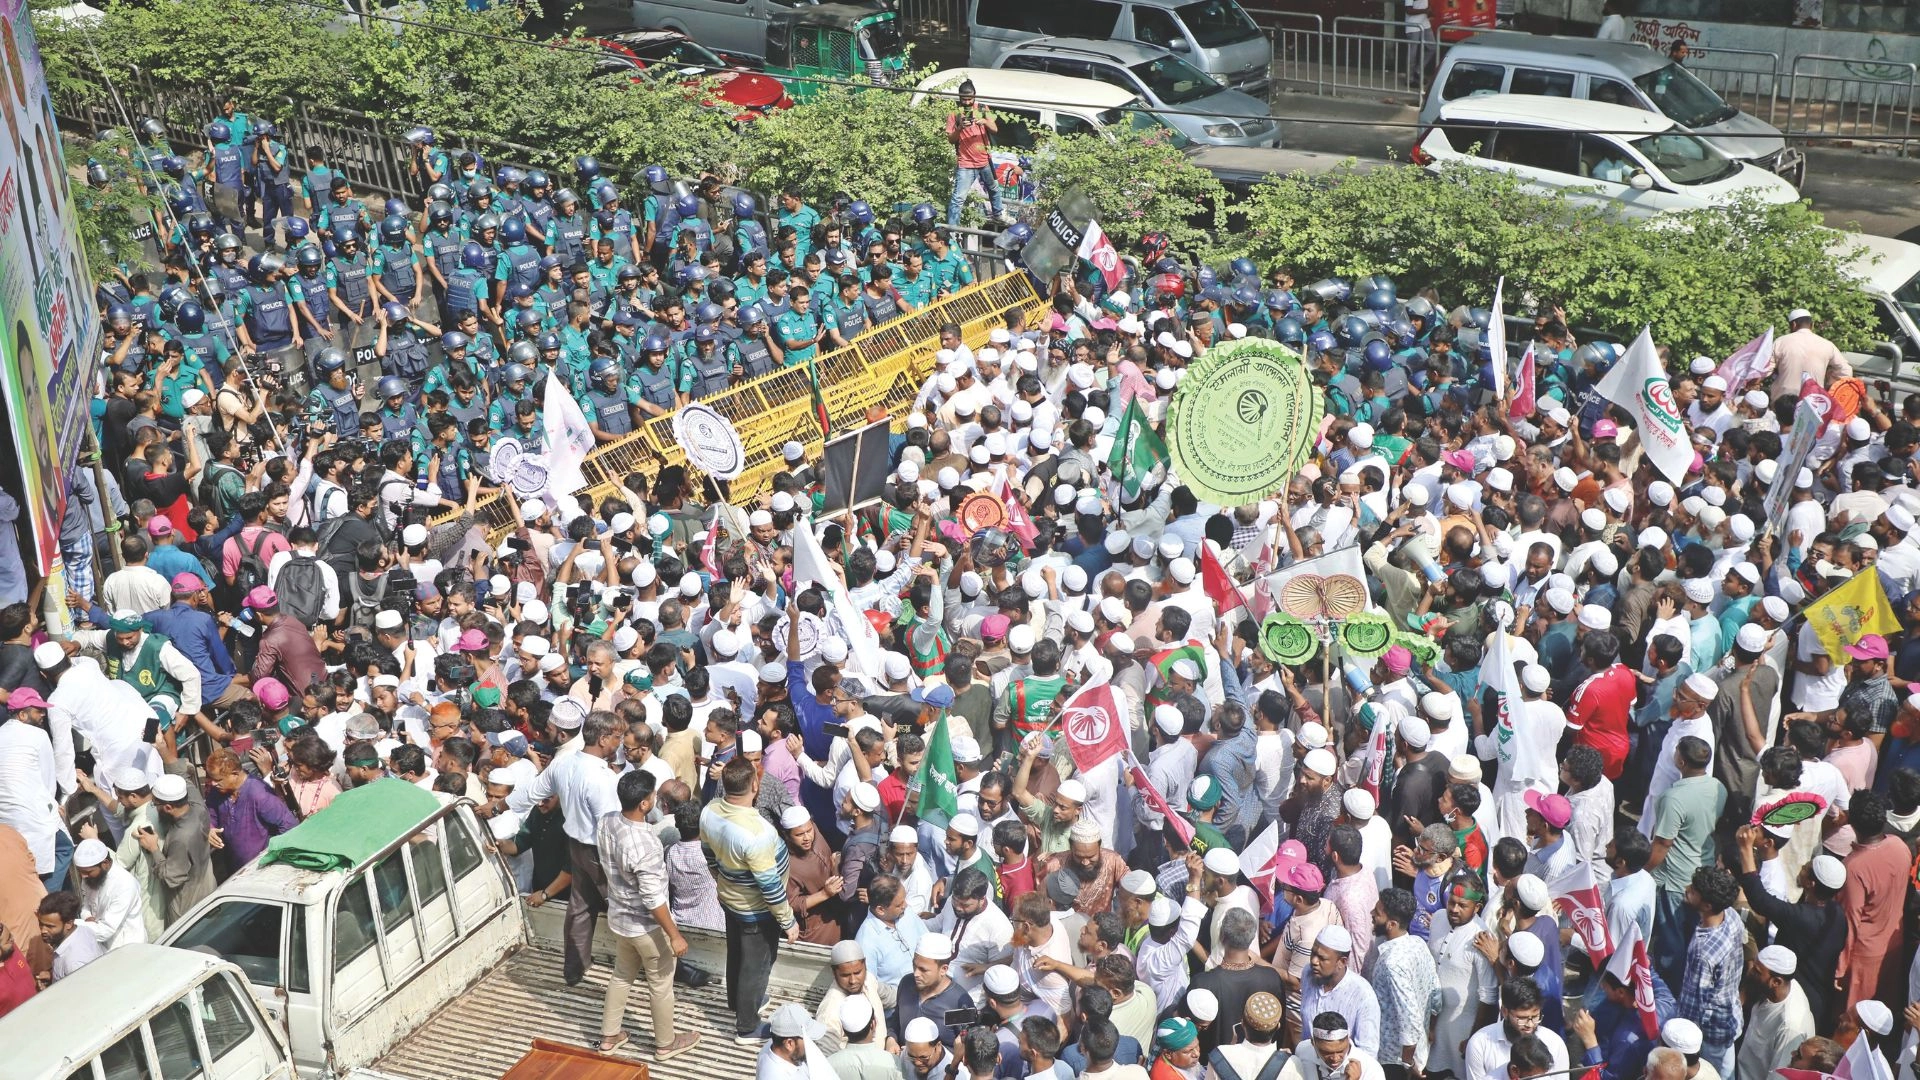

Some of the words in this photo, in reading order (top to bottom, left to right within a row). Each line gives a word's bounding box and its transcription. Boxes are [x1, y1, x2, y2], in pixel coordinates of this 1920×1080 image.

[1662, 22, 1701, 42] অফিস
[221, 155, 237, 163] POLICE
[535, 206, 550, 217] POLICE
[1049, 210, 1080, 247] POLICE
[564, 230, 583, 239] POLICE
[520, 261, 537, 271] POLICE
[346, 268, 365, 277] POLICE
[448, 277, 471, 289] POLICE
[310, 286, 325, 295] POLICE
[262, 301, 283, 311] POLICE
[1206, 358, 1251, 391] ইসলামী
[1253, 362, 1291, 389] আন্দোলন
[1280, 390, 1295, 442] বাংলাদেশ
[604, 403, 625, 415] POLICE
